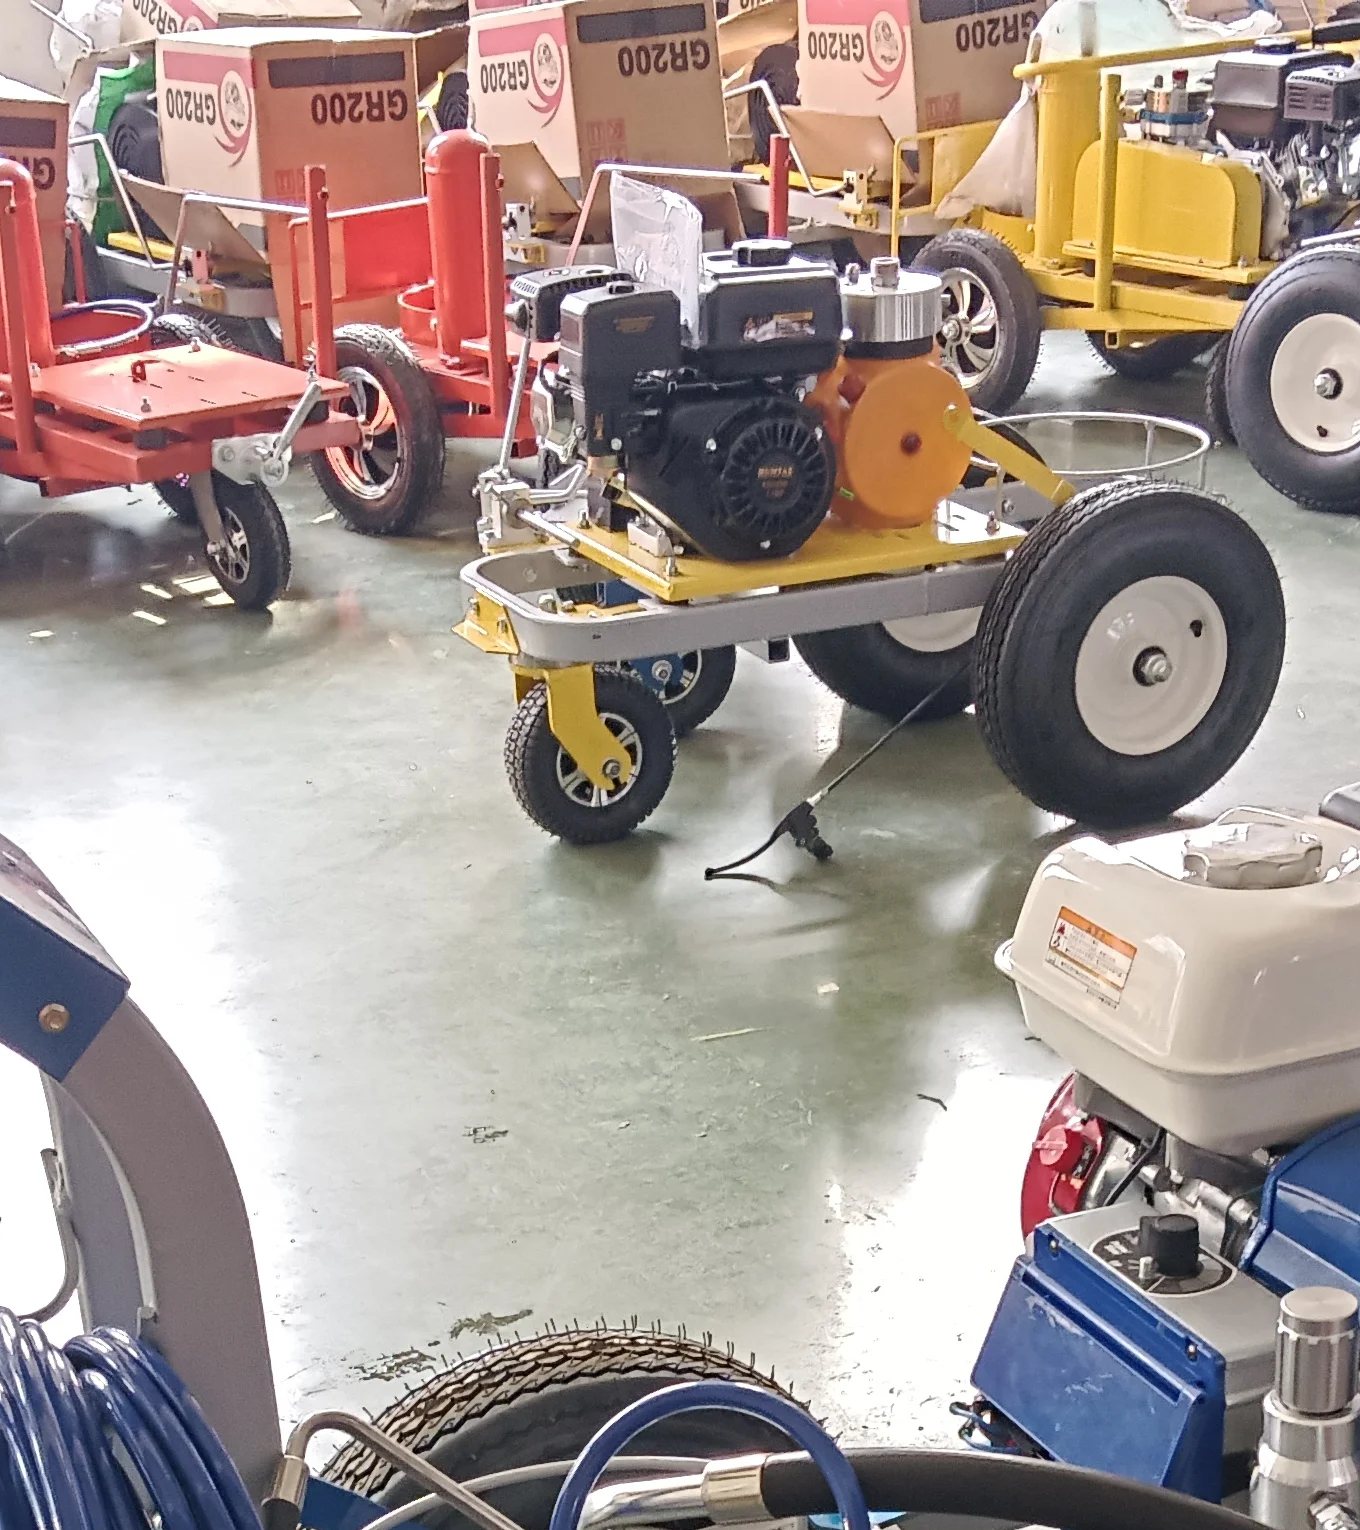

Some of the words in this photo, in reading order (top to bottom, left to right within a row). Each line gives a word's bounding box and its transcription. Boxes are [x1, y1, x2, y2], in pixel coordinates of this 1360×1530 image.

[618, 38, 711, 77] GR200
[808, 30, 864, 63] GR200
[480, 59, 529, 94] GR200
[166, 87, 216, 126] GR200
[311, 88, 409, 125] GR200
